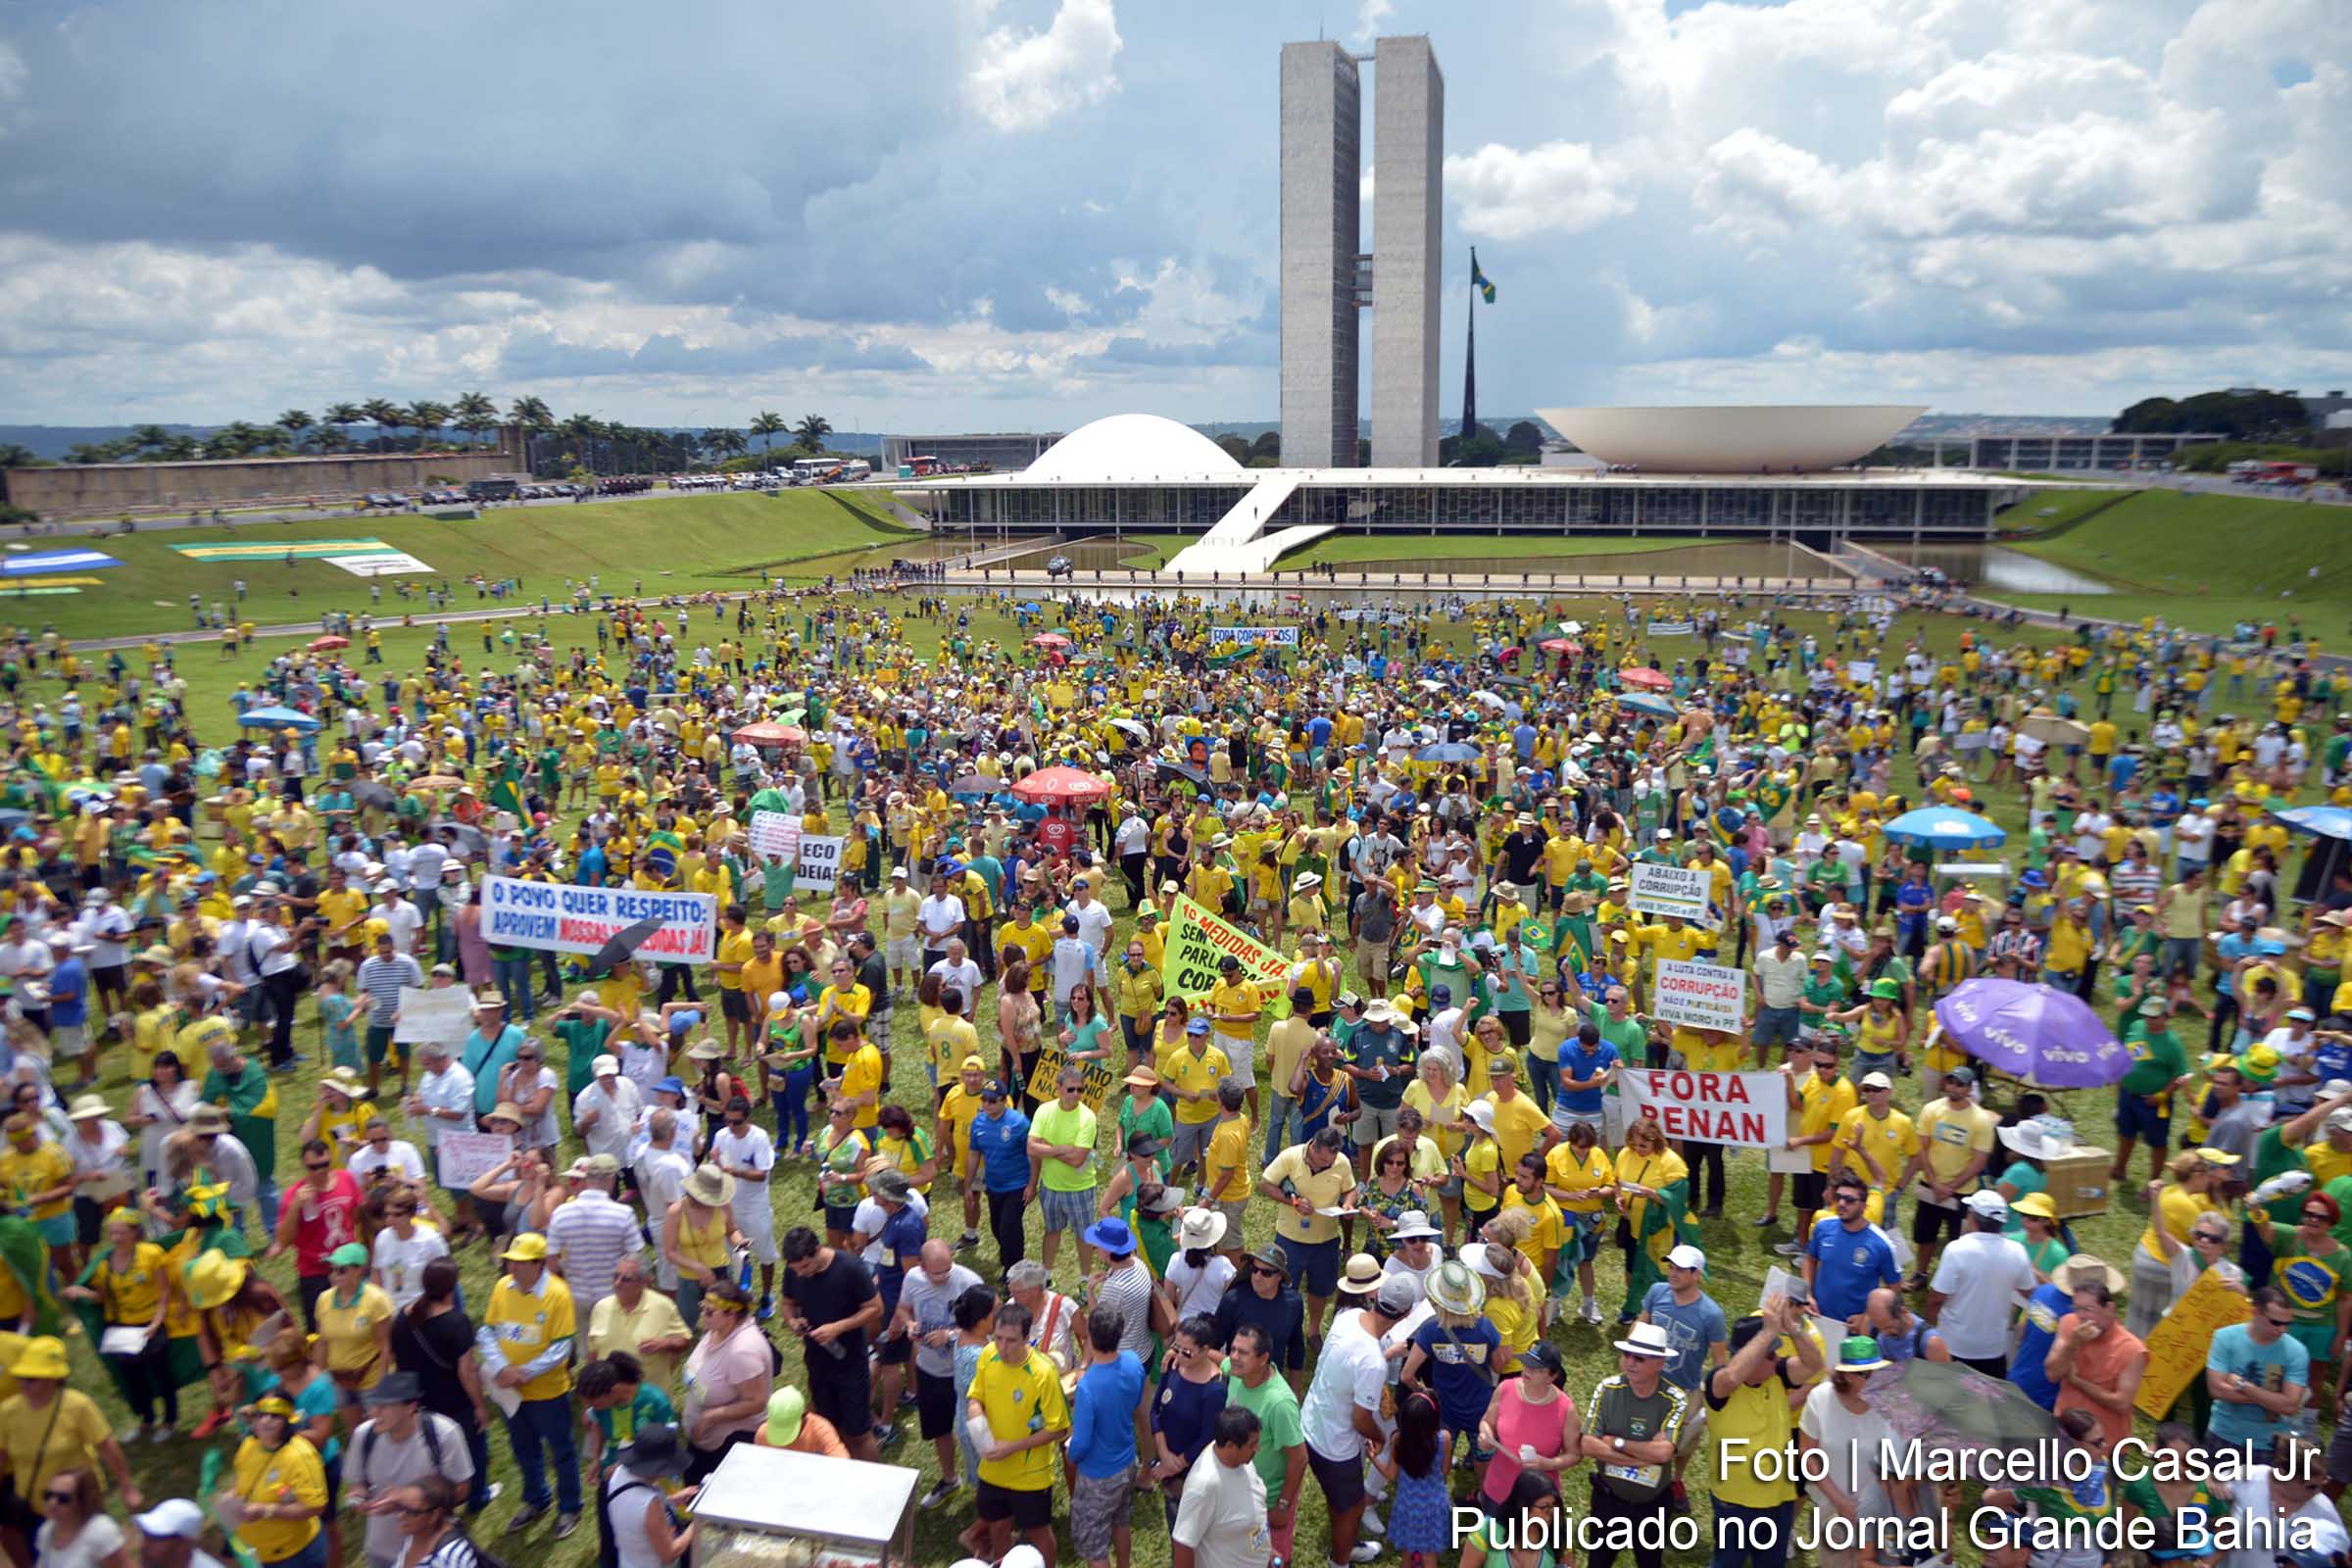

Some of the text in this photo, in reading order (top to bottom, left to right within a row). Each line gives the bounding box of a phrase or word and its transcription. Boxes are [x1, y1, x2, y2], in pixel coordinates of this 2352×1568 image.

[1238, 629, 1296, 642] CORPTOS!
[804, 843, 835, 859] ECO
[1647, 867, 1696, 882] ABAIXO A
[1639, 879, 1701, 897] CORRUPÇÃO
[493, 882, 707, 923] O POVO QUER RESPEITO:
[492, 911, 556, 940] APROVEM
[560, 917, 611, 946] NOSSAS
[1181, 923, 1207, 945] SEM
[1200, 916, 1262, 964] MEDIDAS
[1178, 968, 1215, 992] COR
[1674, 964, 1693, 974] LUTA
[1696, 967, 1727, 979] CONTRA
[1660, 976, 1739, 1000] CORRUPÇÃO
[1659, 1008, 1681, 1019] VIVA
[1684, 1011, 1711, 1024] MORO
[942, 1041, 951, 1059] 8
[1984, 1026, 2029, 1054] vivo
[2041, 1045, 2090, 1064] vivo
[1648, 1071, 1750, 1104] FORA
